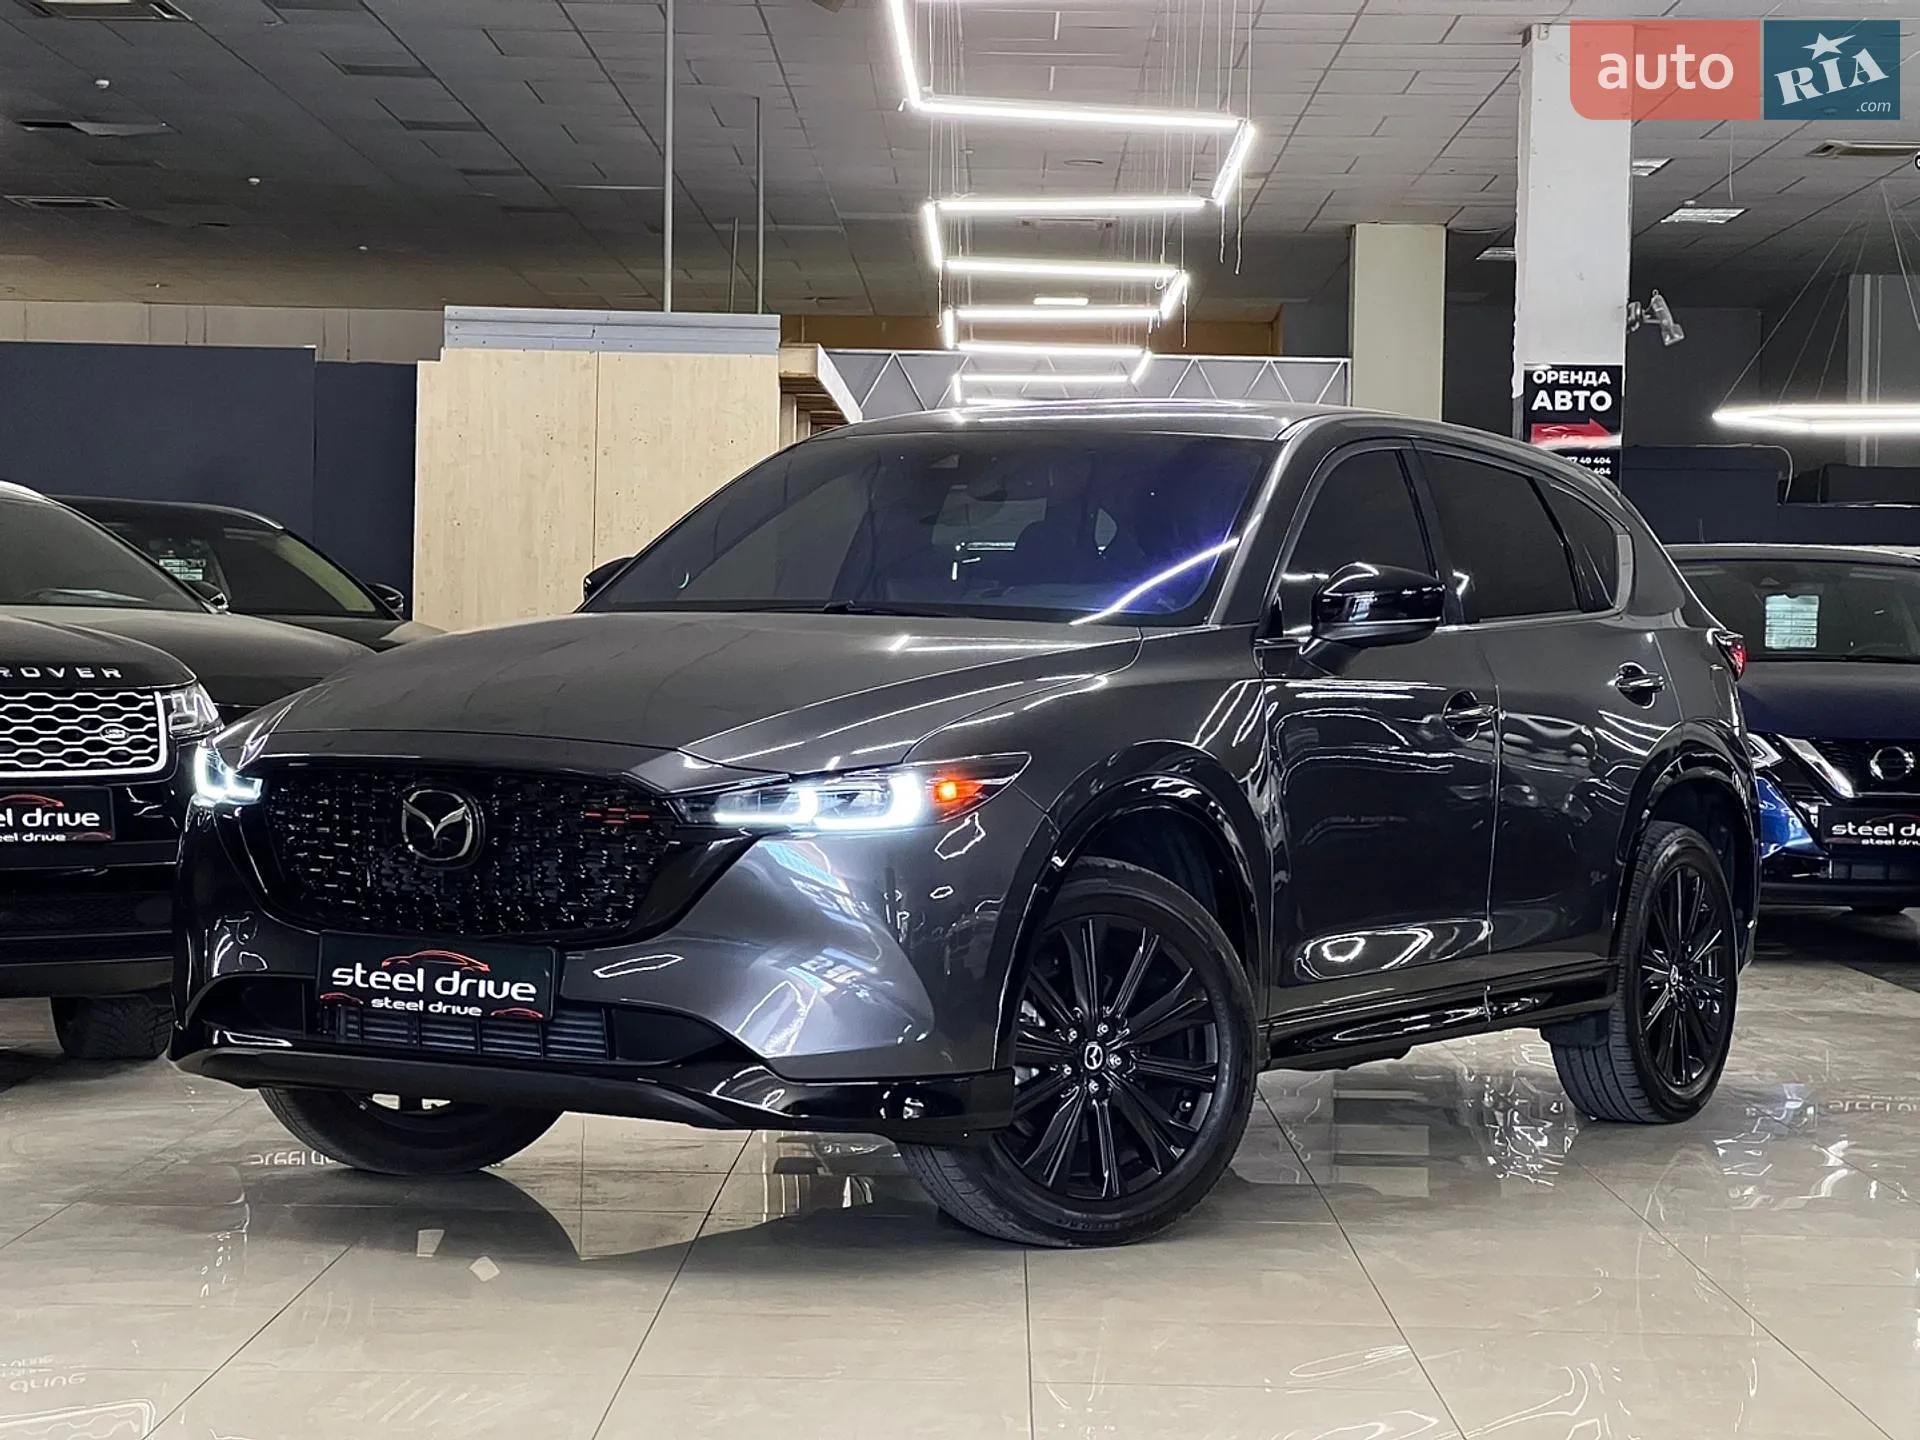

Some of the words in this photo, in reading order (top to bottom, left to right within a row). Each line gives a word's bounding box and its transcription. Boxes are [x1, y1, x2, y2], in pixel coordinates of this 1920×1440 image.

[1532, 370, 1611, 387] ОРЕНДА
[1531, 390, 1612, 412] АВТО
[22, 808, 101, 827] drive
[22, 832, 67, 843] drive
[1831, 821, 1894, 836] steel
[1861, 838, 1895, 846] steel
[332, 963, 424, 992] steel
[434, 971, 537, 1002] drive
[371, 997, 424, 1012] steel
[428, 1003, 483, 1017] drive
